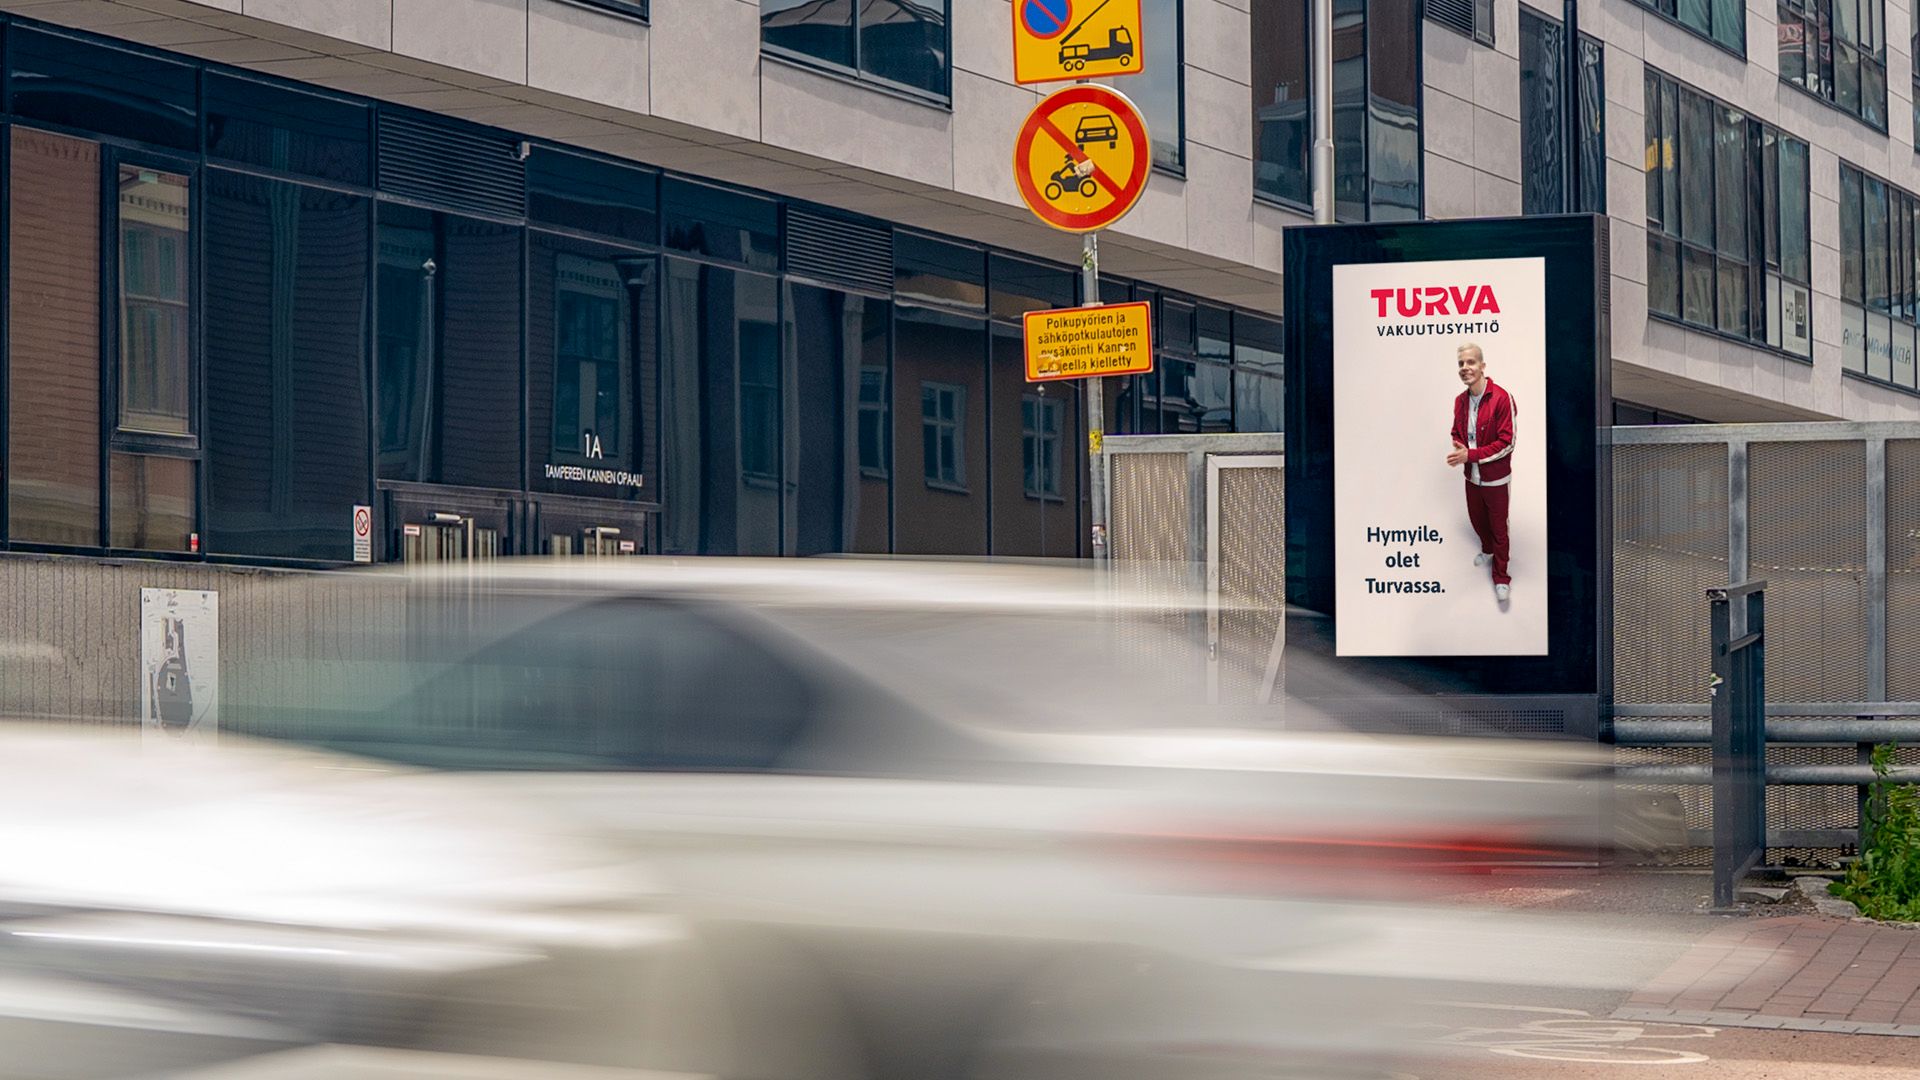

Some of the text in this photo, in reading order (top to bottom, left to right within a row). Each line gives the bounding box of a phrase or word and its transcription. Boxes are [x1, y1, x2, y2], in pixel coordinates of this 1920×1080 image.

[1370, 284, 1500, 318] TURVA
[1046, 312, 1126, 329] Polkupyörien ja
[1377, 320, 1499, 337] VAKUUTUSYHTIÖ
[1038, 327, 1138, 344] sähköpotkulautojen
[1090, 355, 1132, 369] kielletty
[585, 433, 603, 460] 1A
[544, 464, 643, 487] TAMPEREEN KANNEN OPAALI
[1367, 525, 1443, 546] Hymyile,
[1385, 551, 1420, 568] olet
[1365, 578, 1445, 594] Turvassa.
